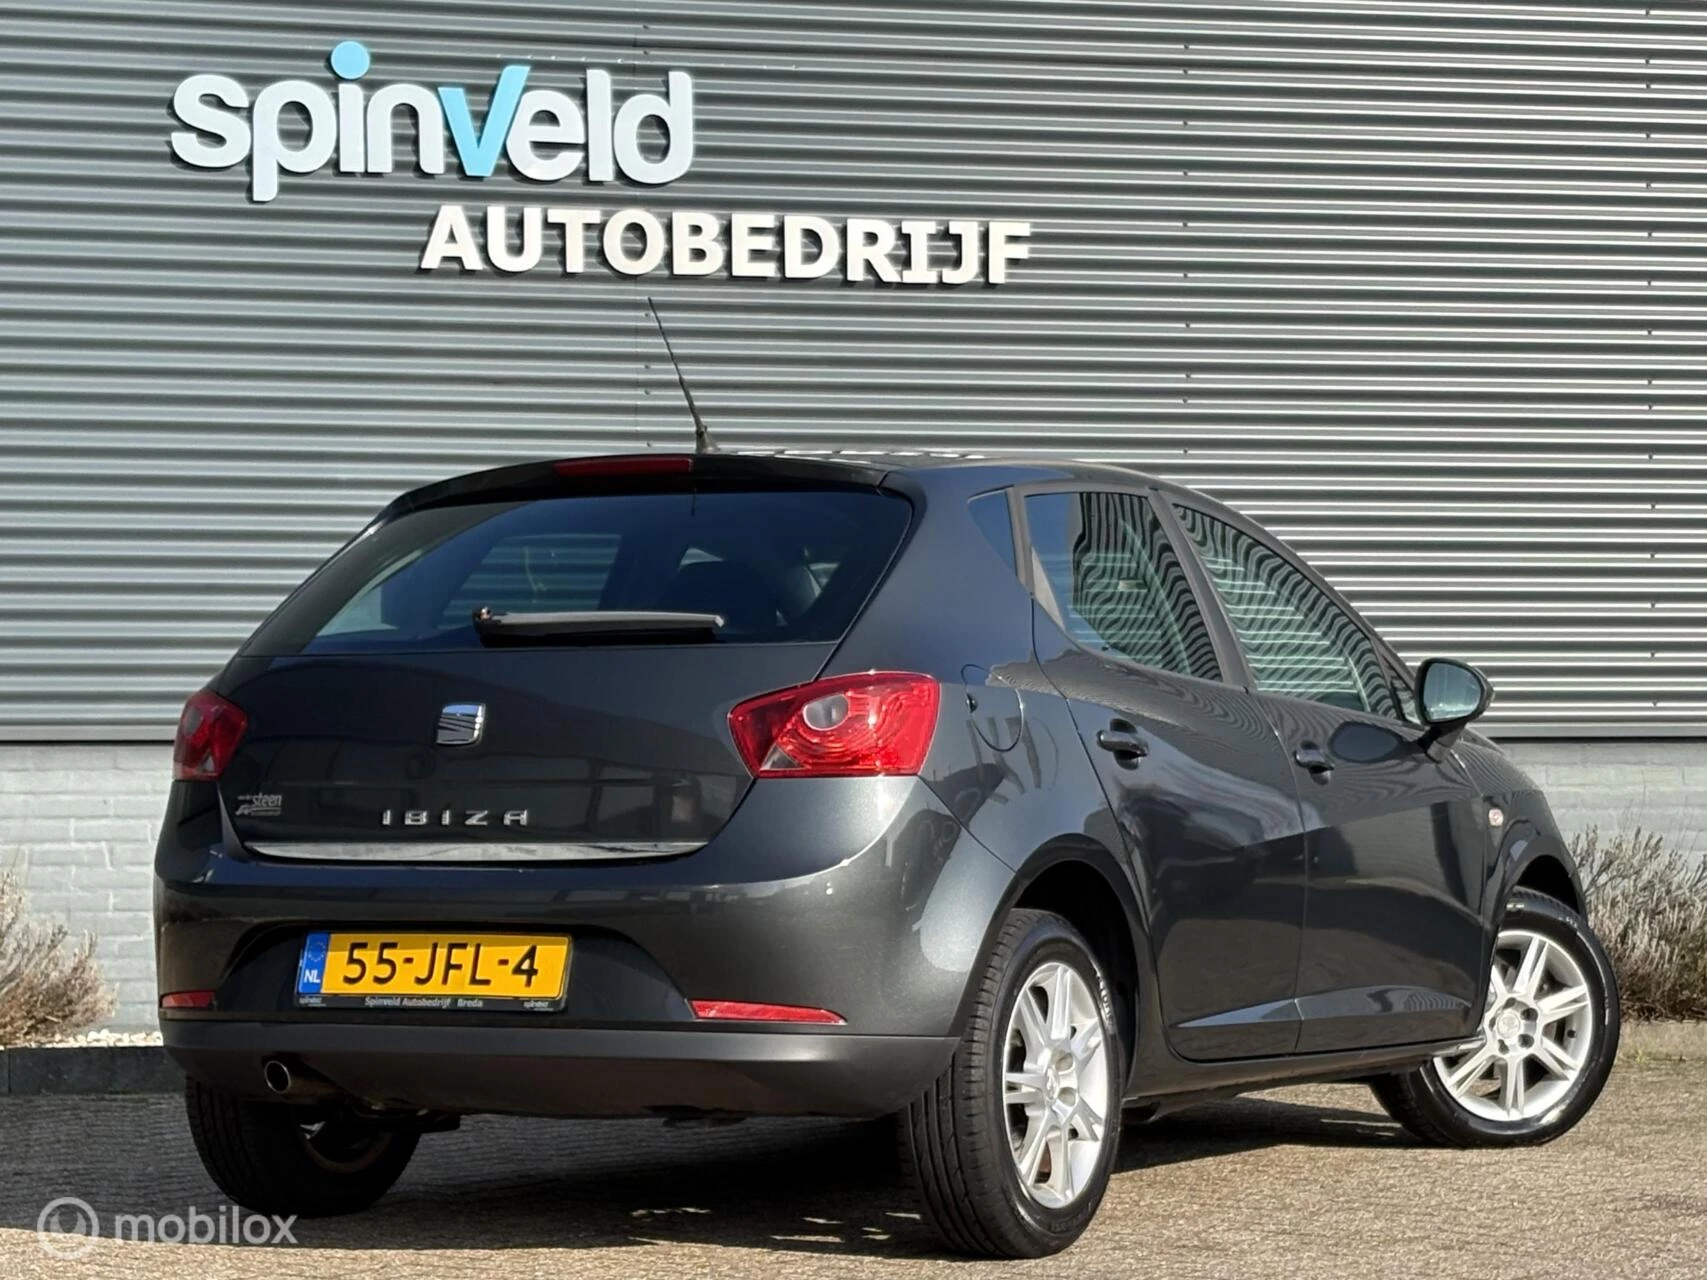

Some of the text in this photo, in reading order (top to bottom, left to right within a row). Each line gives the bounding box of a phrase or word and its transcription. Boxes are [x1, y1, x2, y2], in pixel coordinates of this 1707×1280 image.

[420, 204, 1030, 284] AUTOBEDRIJF
[382, 809, 528, 826] IBIZA
[342, 942, 539, 987] 55-JFL-4
[303, 969, 320, 983] NL
[457, 998, 484, 1008] Breda
